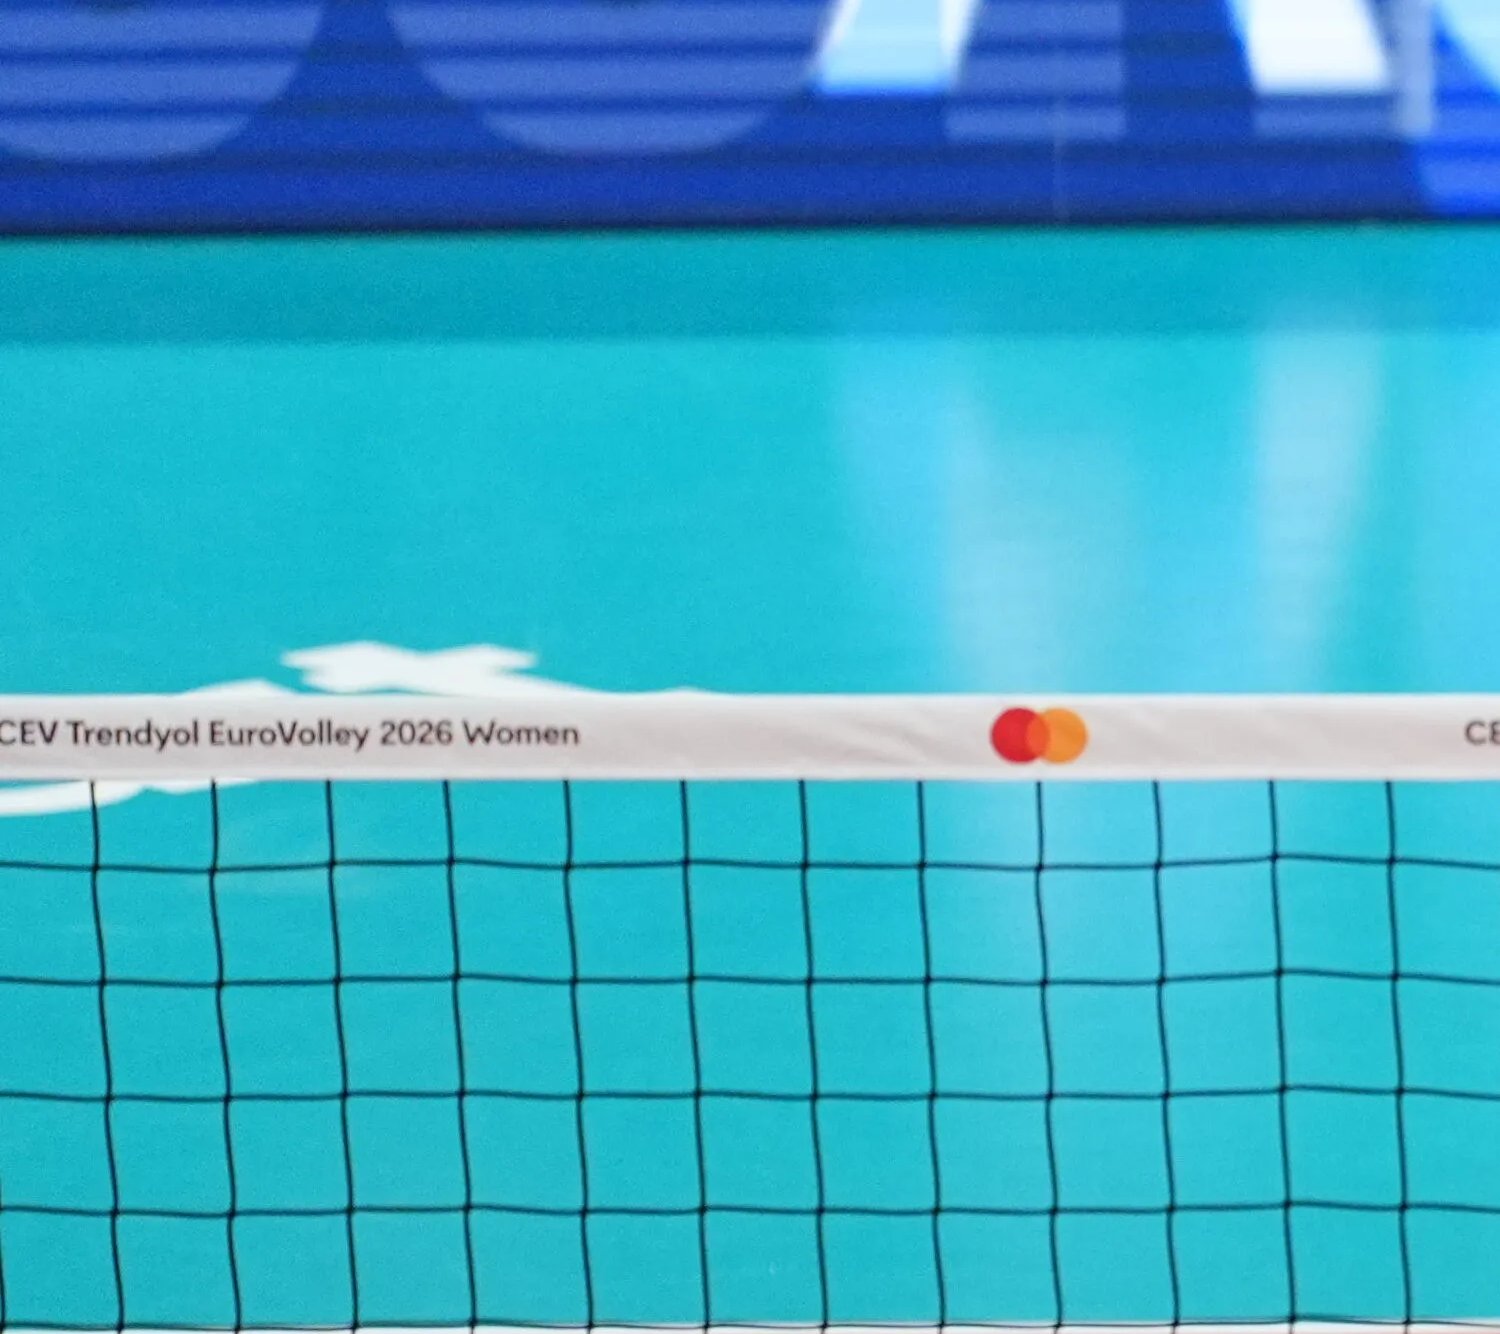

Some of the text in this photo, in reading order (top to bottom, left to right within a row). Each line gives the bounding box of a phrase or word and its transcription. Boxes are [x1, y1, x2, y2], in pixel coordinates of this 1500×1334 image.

[0, 719, 579, 752] CEV Trendyol EuroVolley 2026 Women
